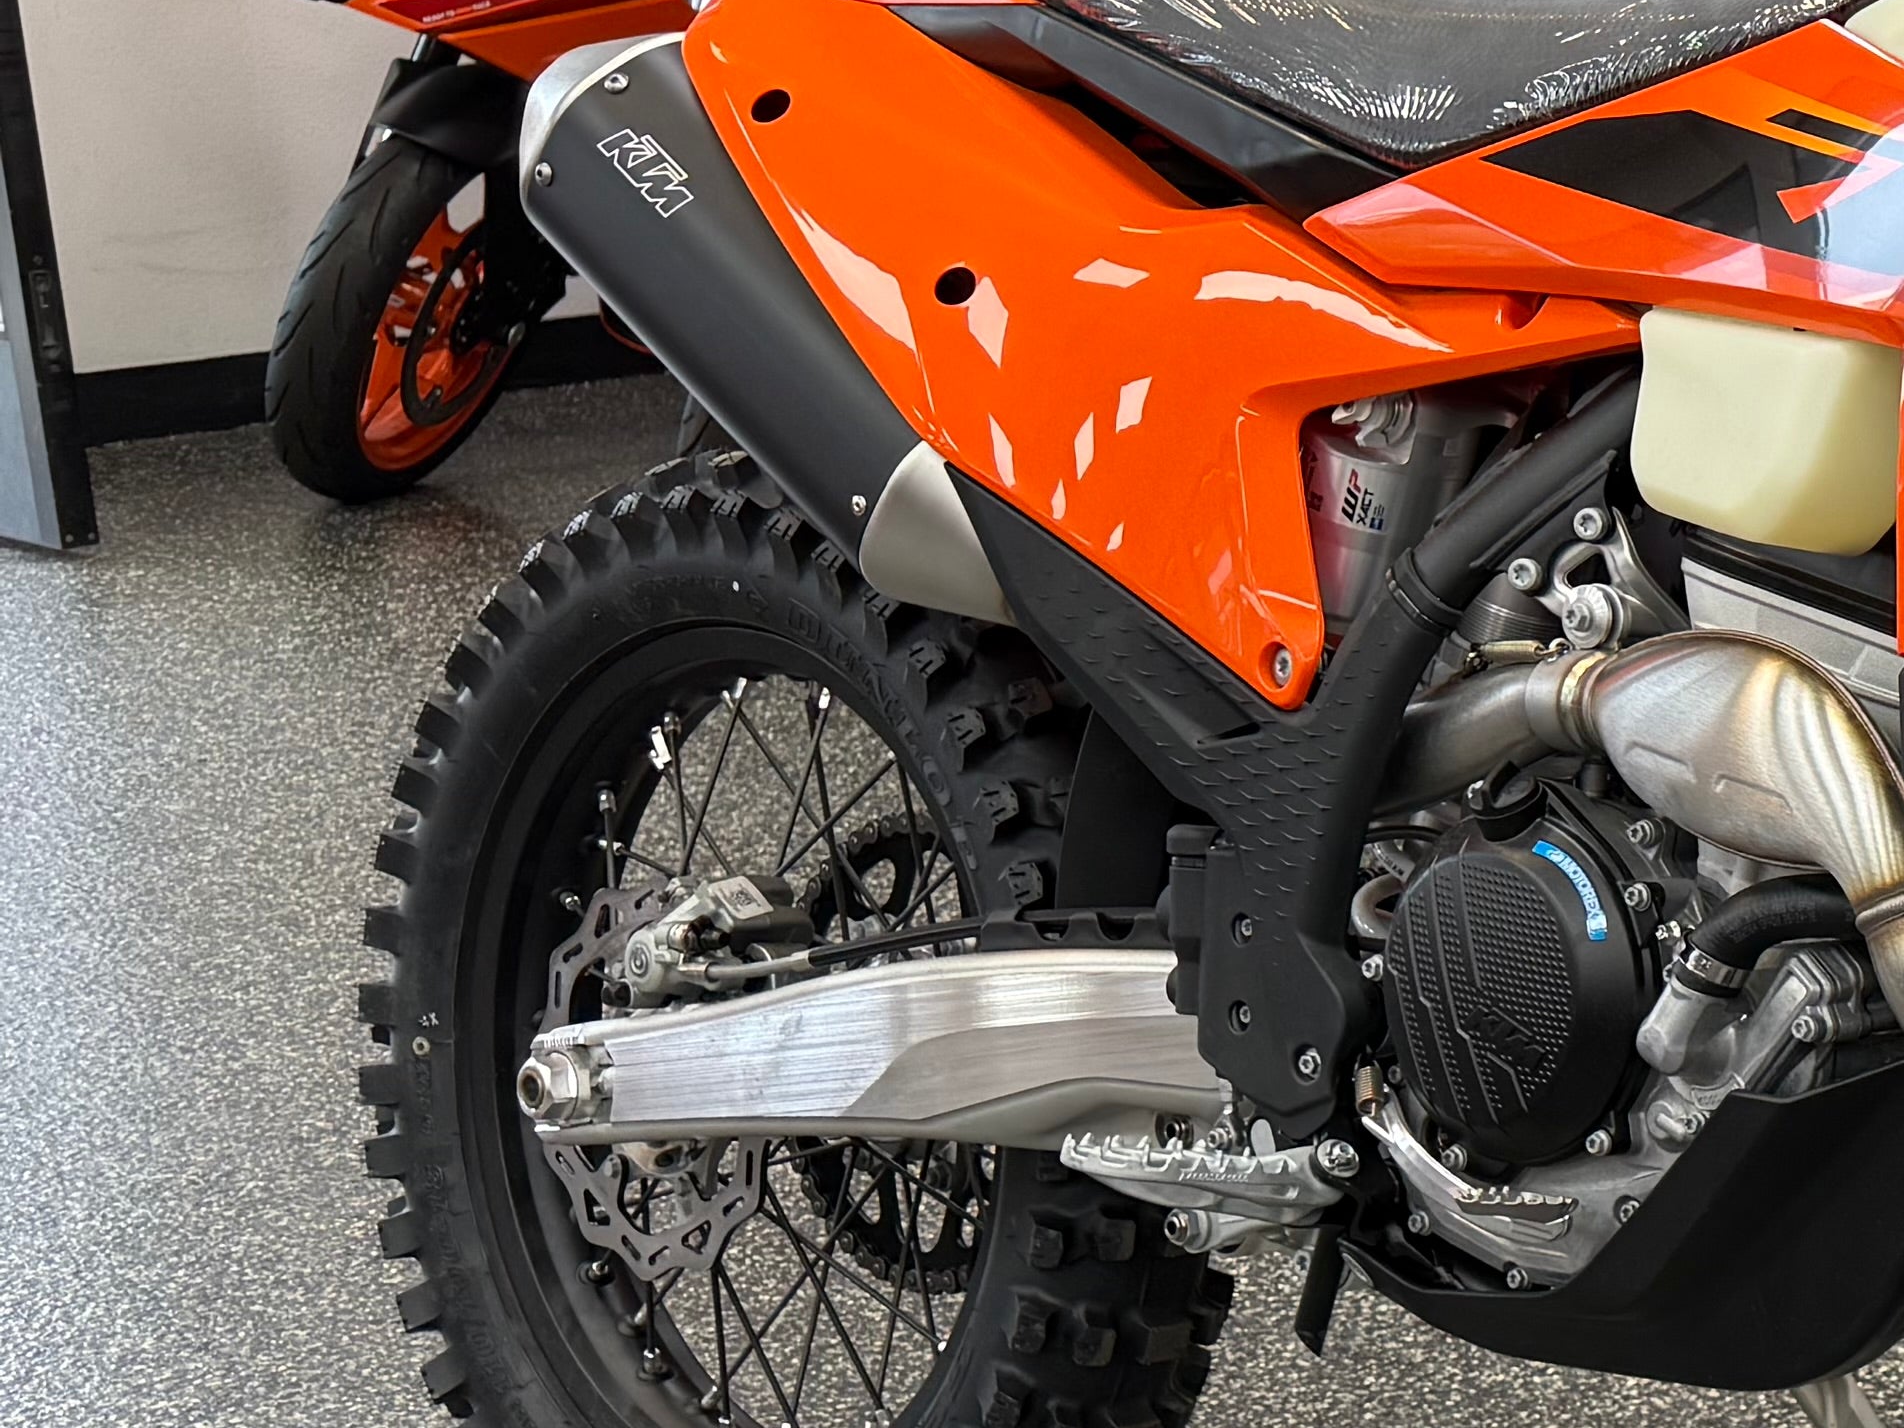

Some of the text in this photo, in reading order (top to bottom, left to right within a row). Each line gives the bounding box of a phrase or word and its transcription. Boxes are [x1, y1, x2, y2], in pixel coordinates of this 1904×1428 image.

[597, 128, 694, 218] KTM
[1341, 467, 1362, 523] WP
[1356, 487, 1375, 526] XACT
